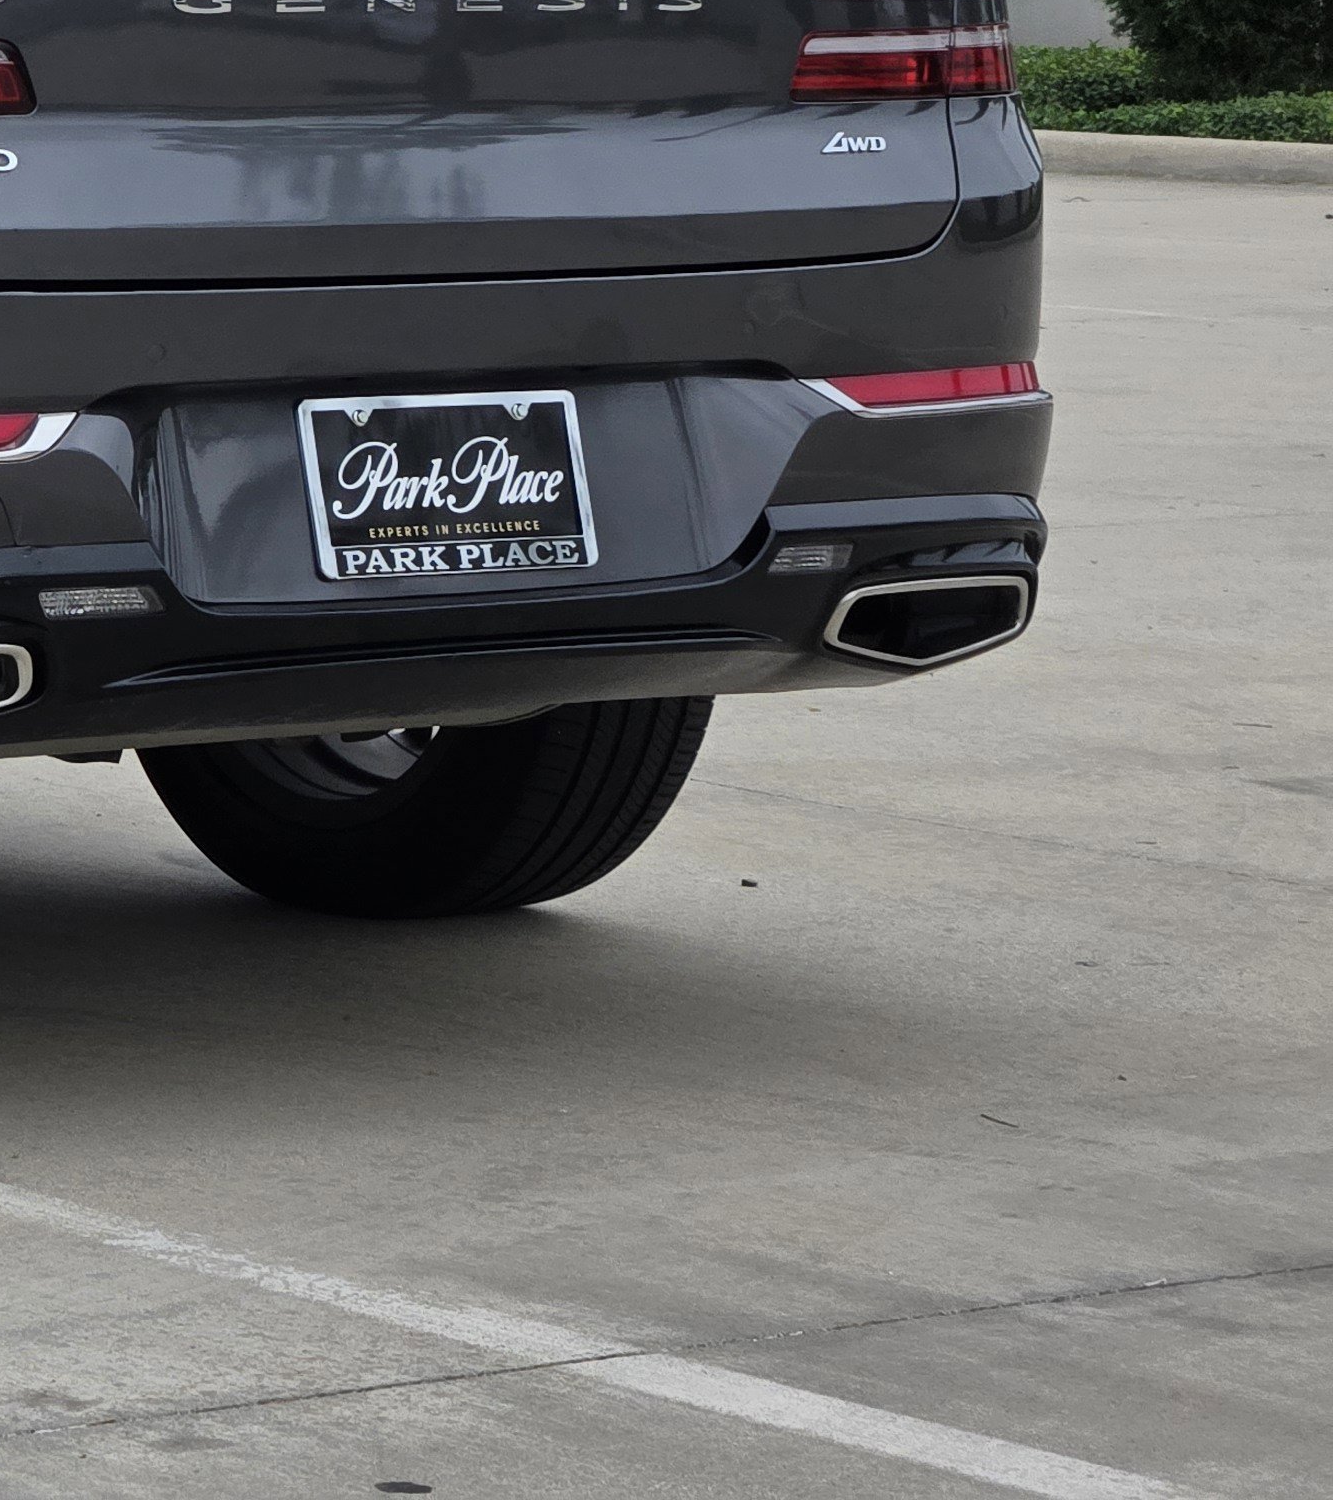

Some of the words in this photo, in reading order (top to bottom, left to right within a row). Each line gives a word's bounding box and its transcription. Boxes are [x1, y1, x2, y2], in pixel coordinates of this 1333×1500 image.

[821, 132, 887, 153] 4WD
[333, 441, 450, 520] Park
[446, 436, 564, 514] Place
[369, 525, 429, 539] EXPERTS
[436, 524, 449, 535] IN
[456, 520, 541, 534] EXCELLENCE
[342, 546, 450, 575] PARK
[456, 540, 580, 569] PLACE
